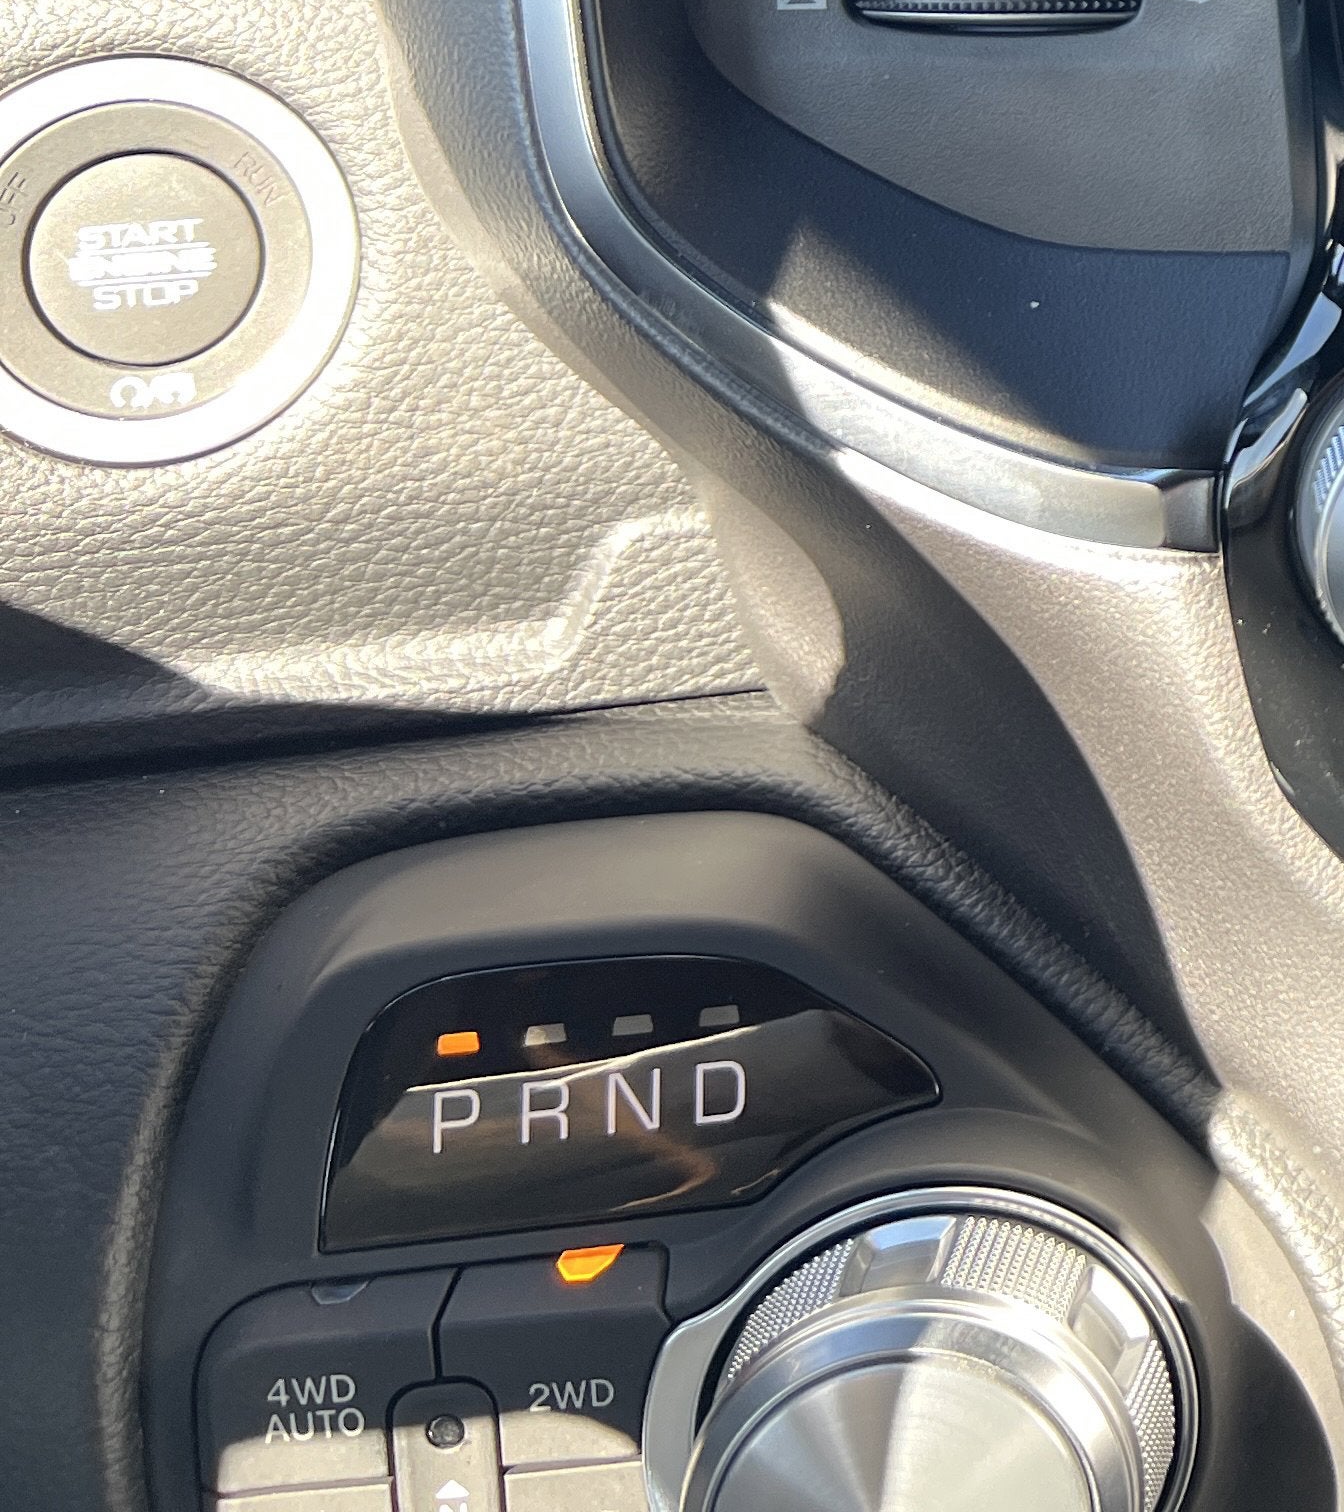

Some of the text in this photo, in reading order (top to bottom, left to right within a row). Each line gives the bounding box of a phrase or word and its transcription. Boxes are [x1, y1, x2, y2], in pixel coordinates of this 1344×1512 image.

[77, 218, 204, 248] START
[432, 1060, 746, 1153] P R N D
[267, 1375, 356, 1407] 4WD
[528, 1379, 614, 1413] 2WD
[265, 1407, 365, 1444] AUTO
